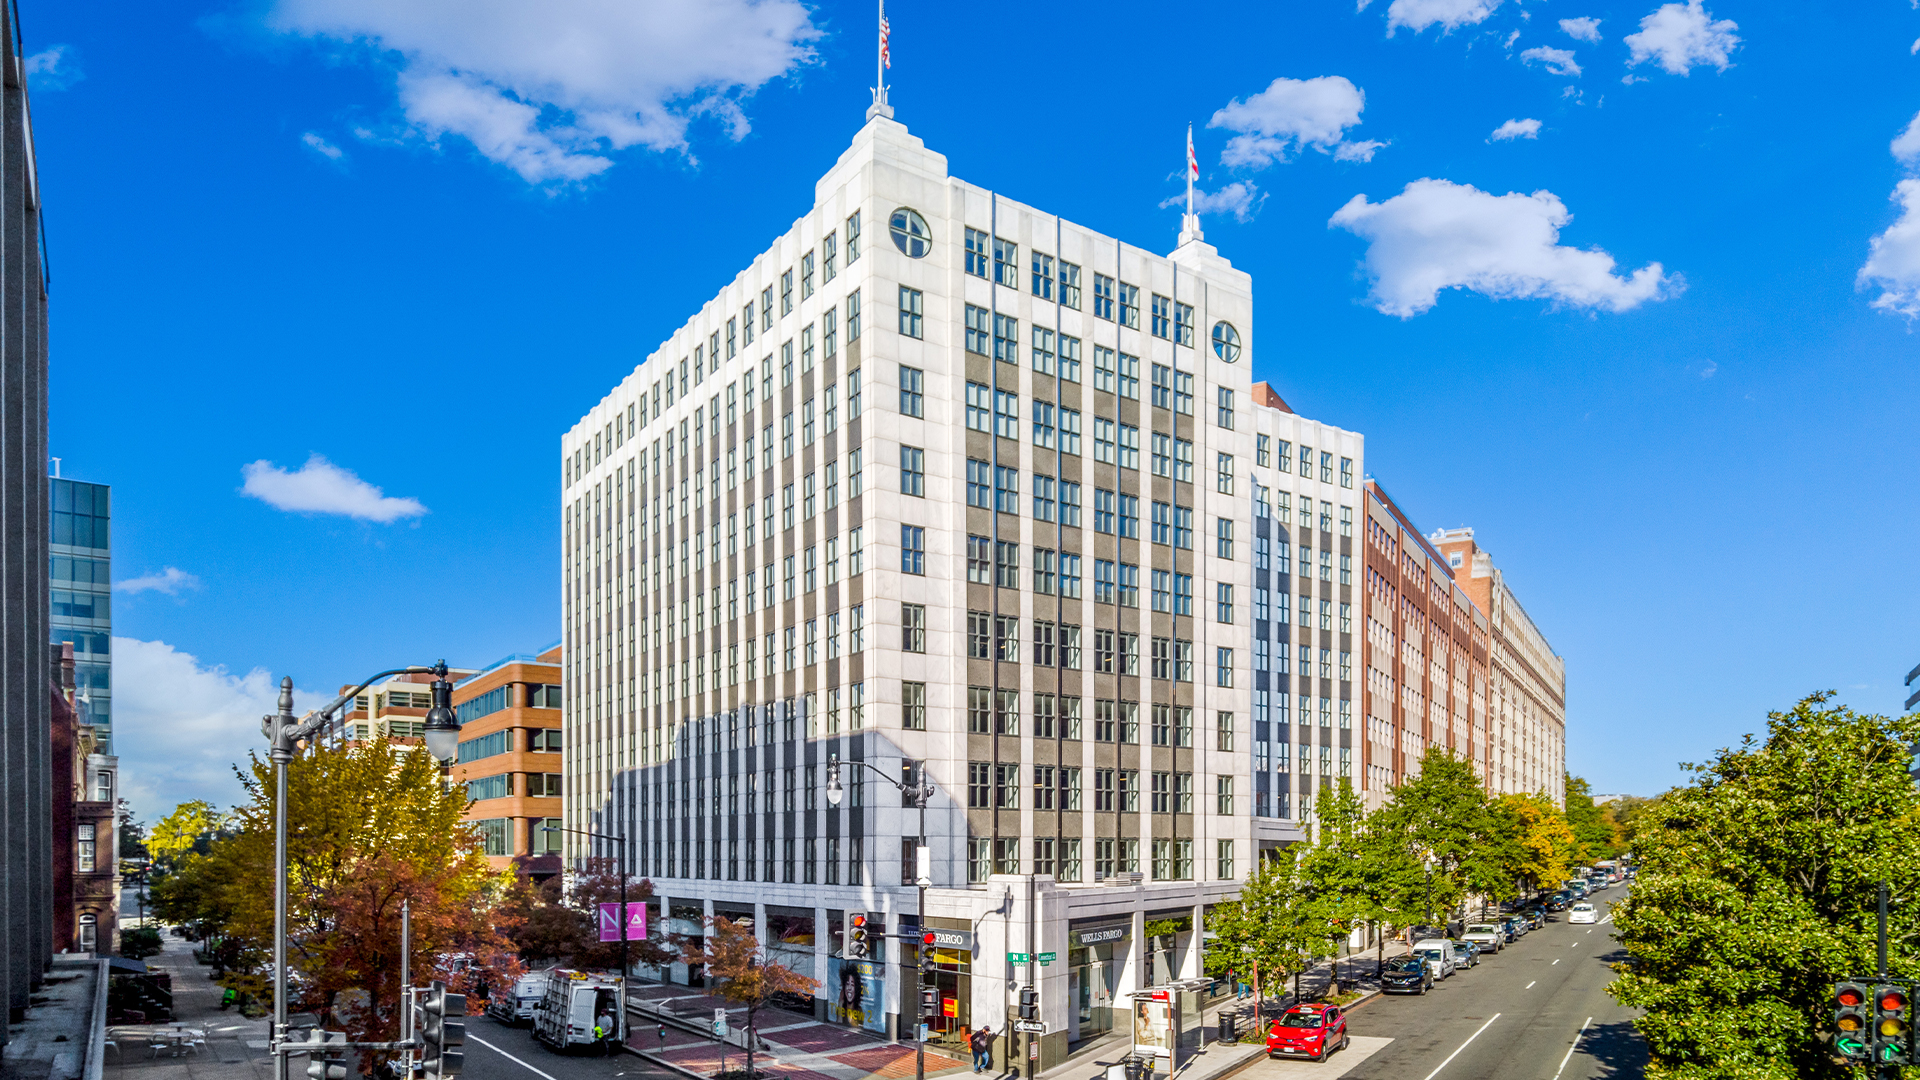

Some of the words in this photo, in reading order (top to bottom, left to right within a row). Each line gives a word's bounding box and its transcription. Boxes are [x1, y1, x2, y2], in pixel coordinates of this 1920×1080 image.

[602, 908, 619, 929] N
[935, 933, 963, 945] FARGO
[1081, 931, 1102, 943] WELLS
[1103, 929, 1122, 940] FARGO
[1012, 953, 1019, 961] N
[857, 964, 873, 975] $200
[829, 1002, 846, 1018] The
[846, 1008, 865, 1021] new
